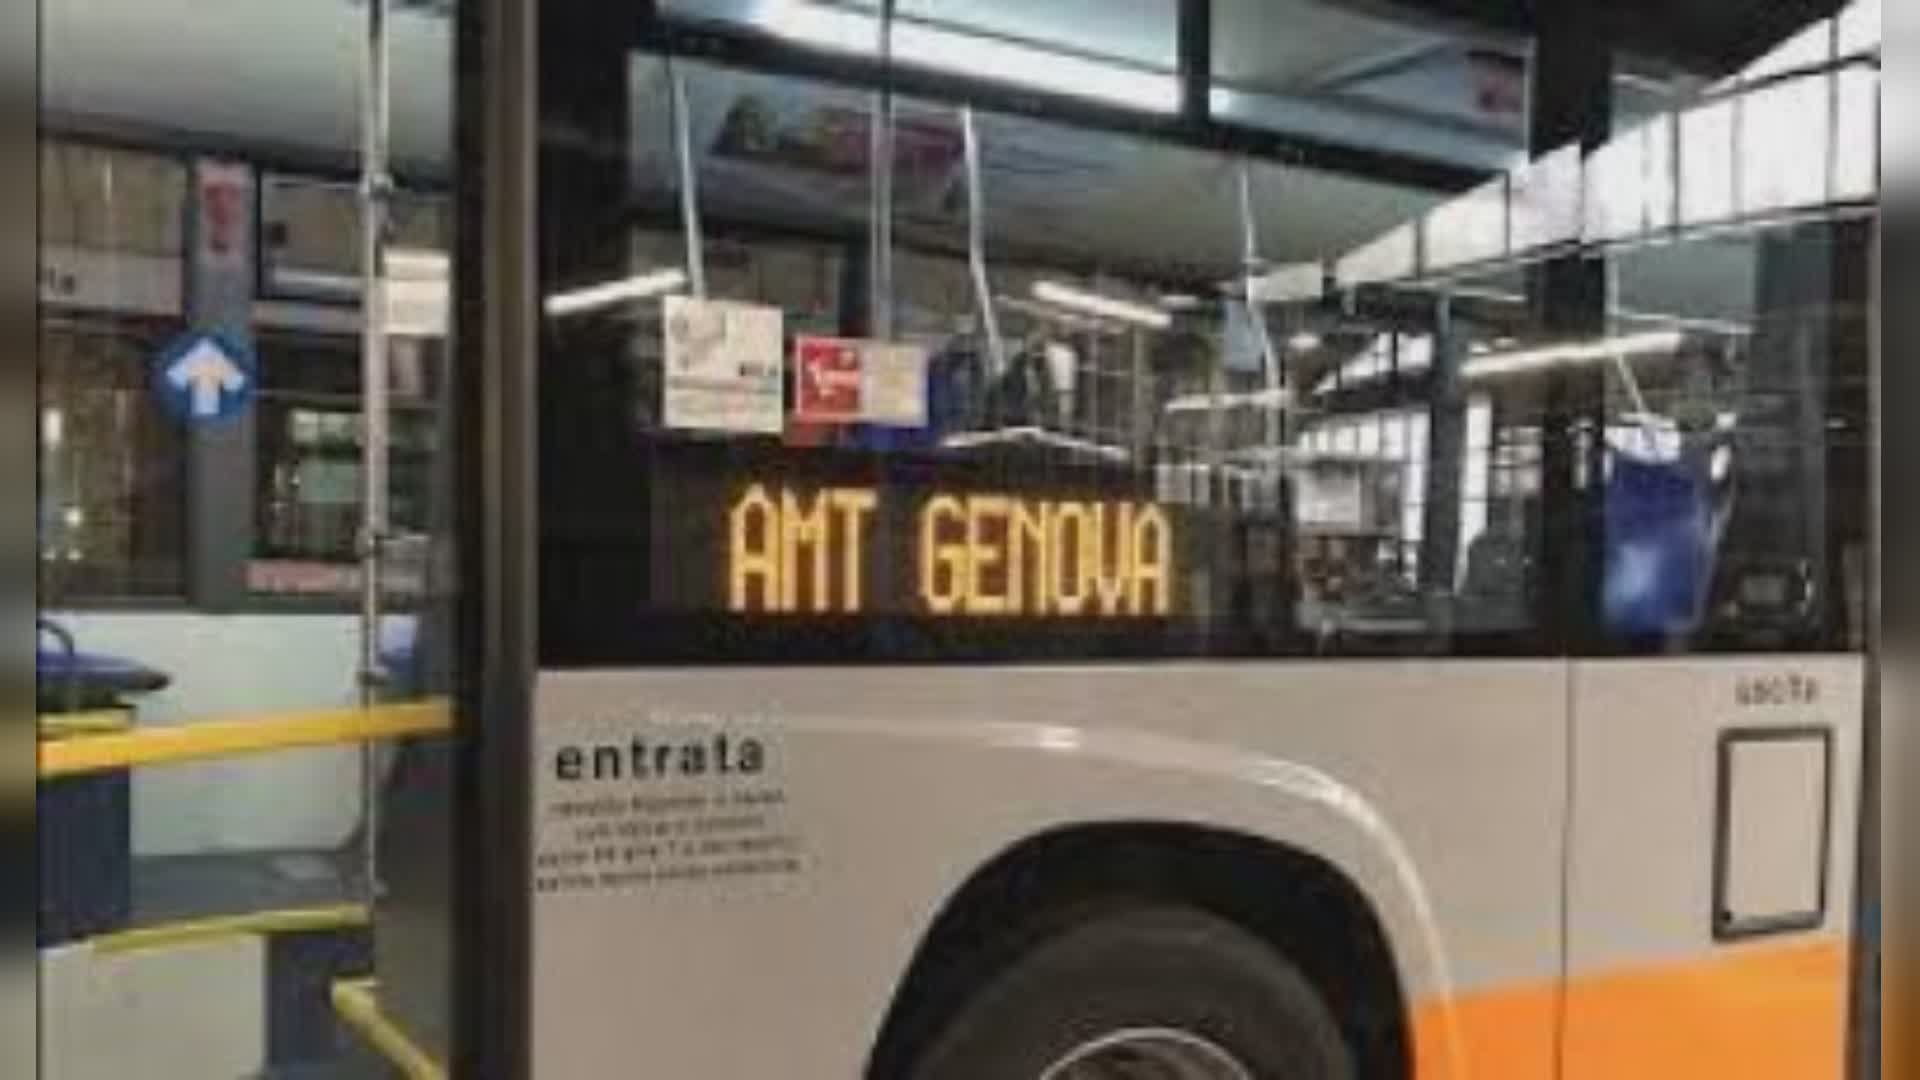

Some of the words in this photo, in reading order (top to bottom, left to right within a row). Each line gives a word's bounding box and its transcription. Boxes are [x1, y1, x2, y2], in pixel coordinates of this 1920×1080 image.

[730, 484, 877, 612] AMT
[921, 496, 1173, 615] GENOVA
[555, 733, 765, 780] entrata
